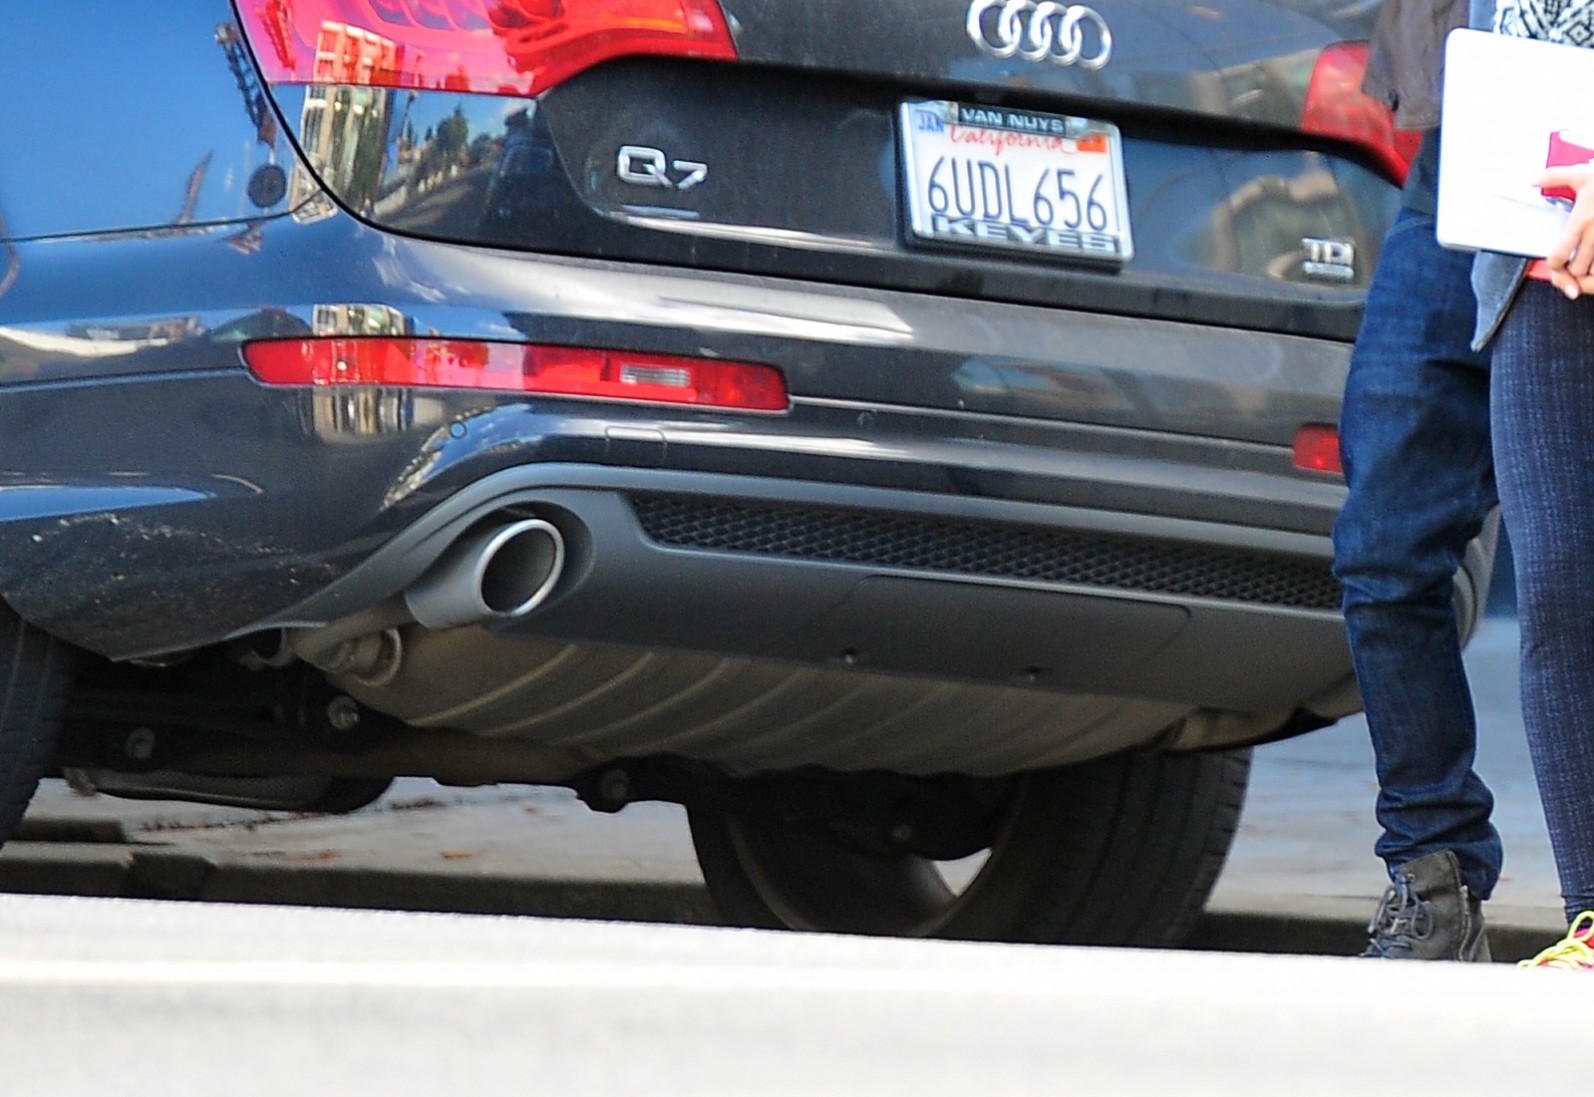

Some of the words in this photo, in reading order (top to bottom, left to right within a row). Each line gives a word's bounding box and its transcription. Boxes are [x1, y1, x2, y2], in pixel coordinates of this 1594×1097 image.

[950, 123, 1062, 156] California
[961, 108, 1003, 125] VAN
[1009, 114, 1065, 132] NUYS
[618, 145, 707, 189] Q7
[928, 156, 1107, 232] 6UDL656
[932, 213, 1119, 252] KEYES
